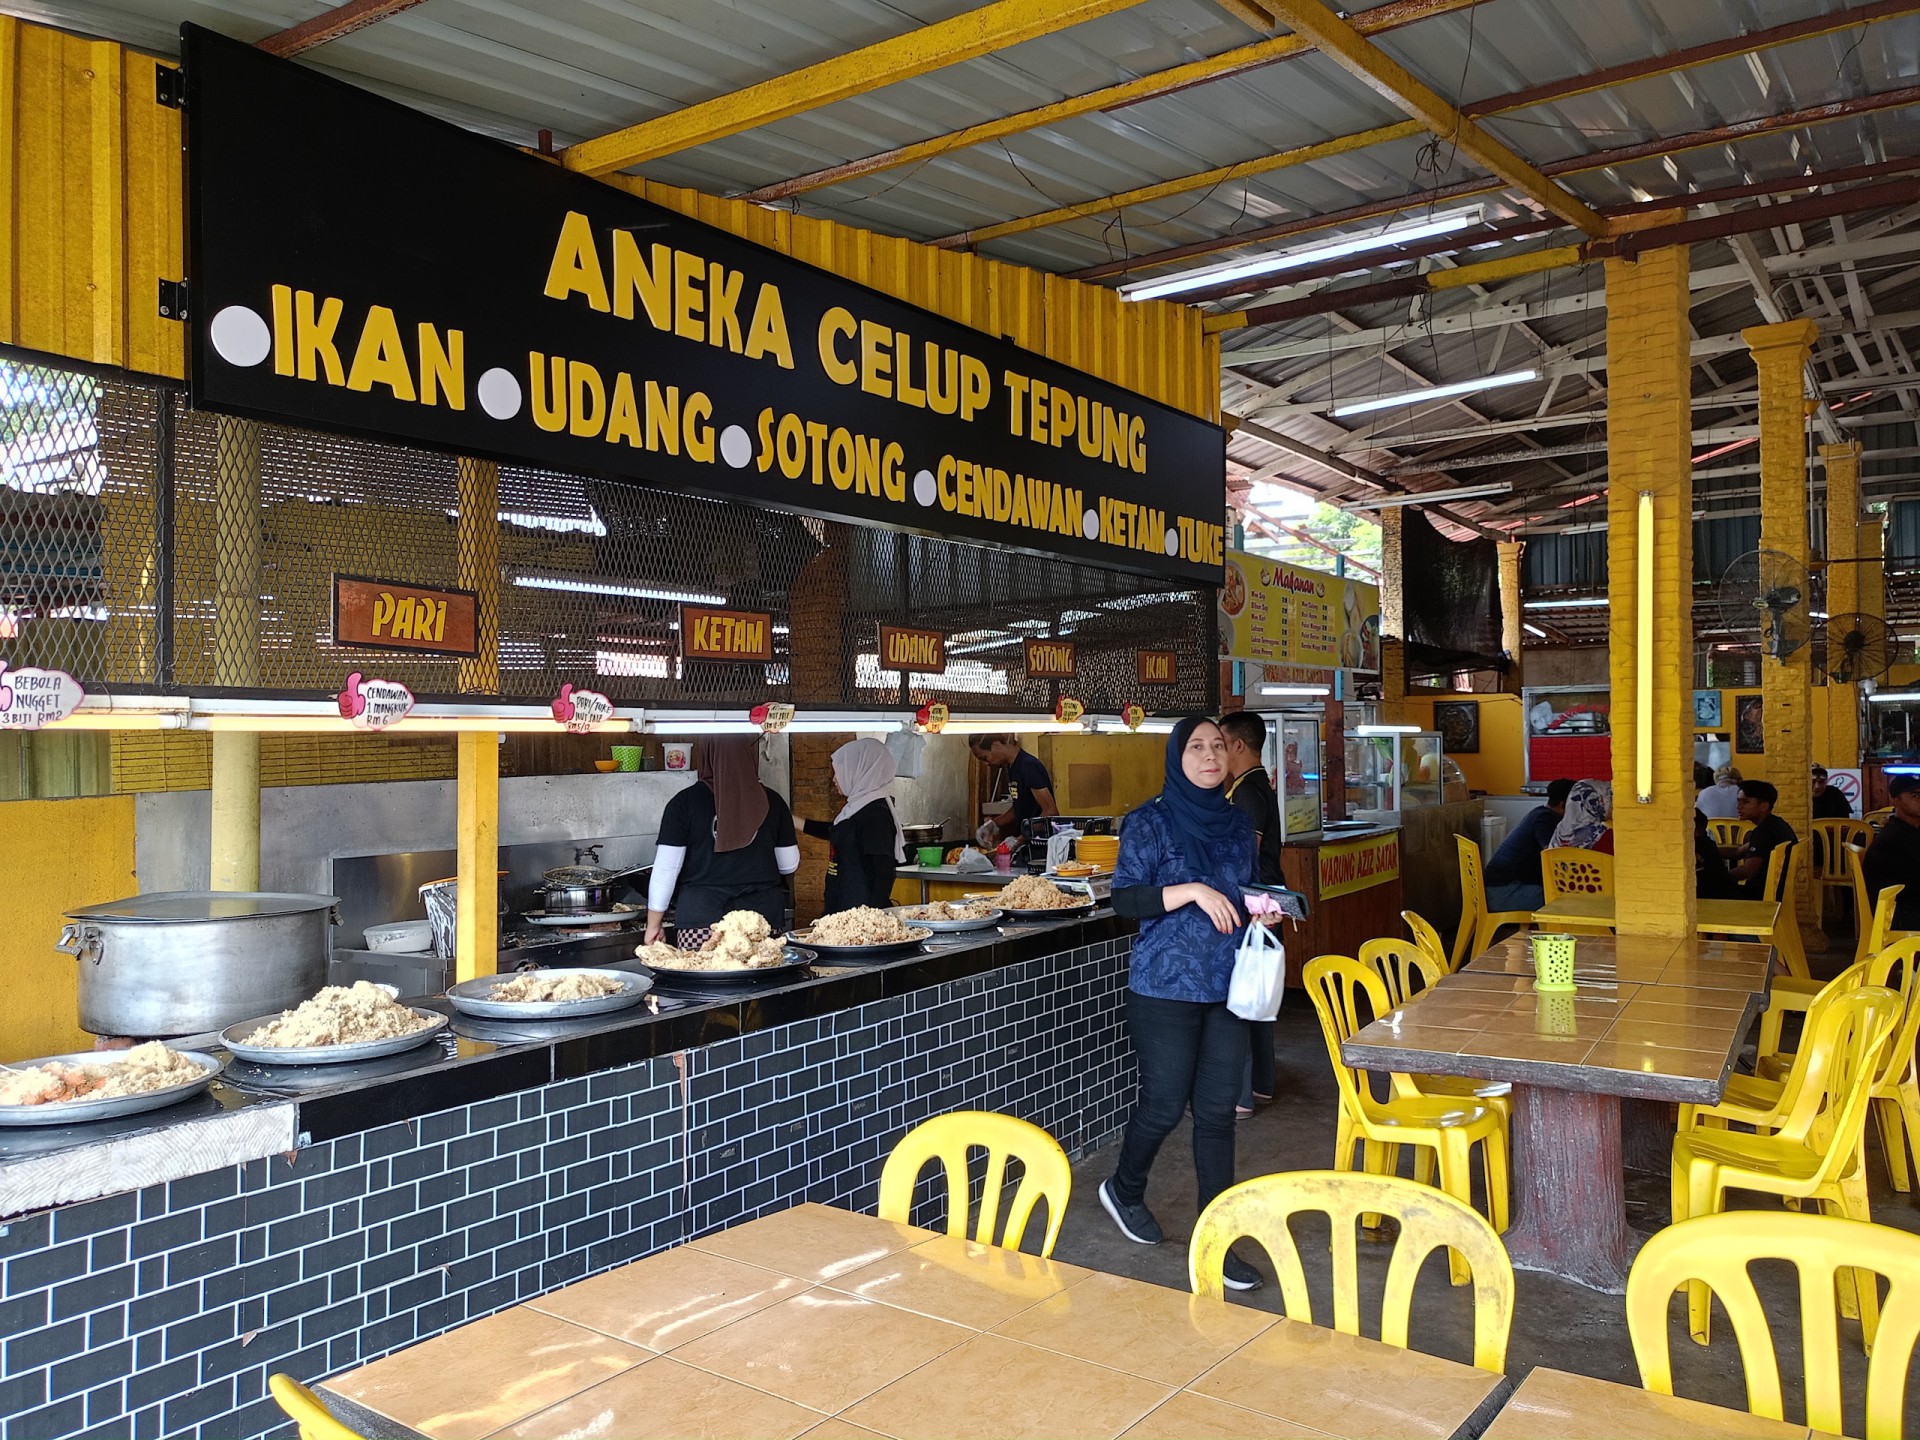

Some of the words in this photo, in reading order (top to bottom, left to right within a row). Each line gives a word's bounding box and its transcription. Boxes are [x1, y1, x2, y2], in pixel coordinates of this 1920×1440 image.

[543, 210, 795, 370] ANEKA
[818, 306, 991, 422] CELUP
[1004, 369, 1148, 475] TEPUNG
[272, 284, 465, 411] IKAN
[529, 350, 715, 464] UDANG
[757, 406, 906, 503] SOTONG
[937, 454, 1083, 538] CENDAWAN
[1099, 496, 1165, 555] KETAM
[1177, 515, 1224, 566] TUKE
[371, 592, 448, 642] PARI
[693, 616, 763, 653] KETAM
[888, 632, 938, 666] UDANG
[1029, 644, 1073, 674] SOTONG
[1146, 656, 1169, 679] IKAN
[14, 675, 62, 690] BEBOLA
[367, 686, 409, 701] CENDAWAN
[16, 693, 61, 712] NUGGET
[367, 702, 371, 713] 1
[1320, 852, 1354, 889] WARUNG
[1356, 848, 1374, 879] AZIZ
[1376, 842, 1397, 873] SATAR
